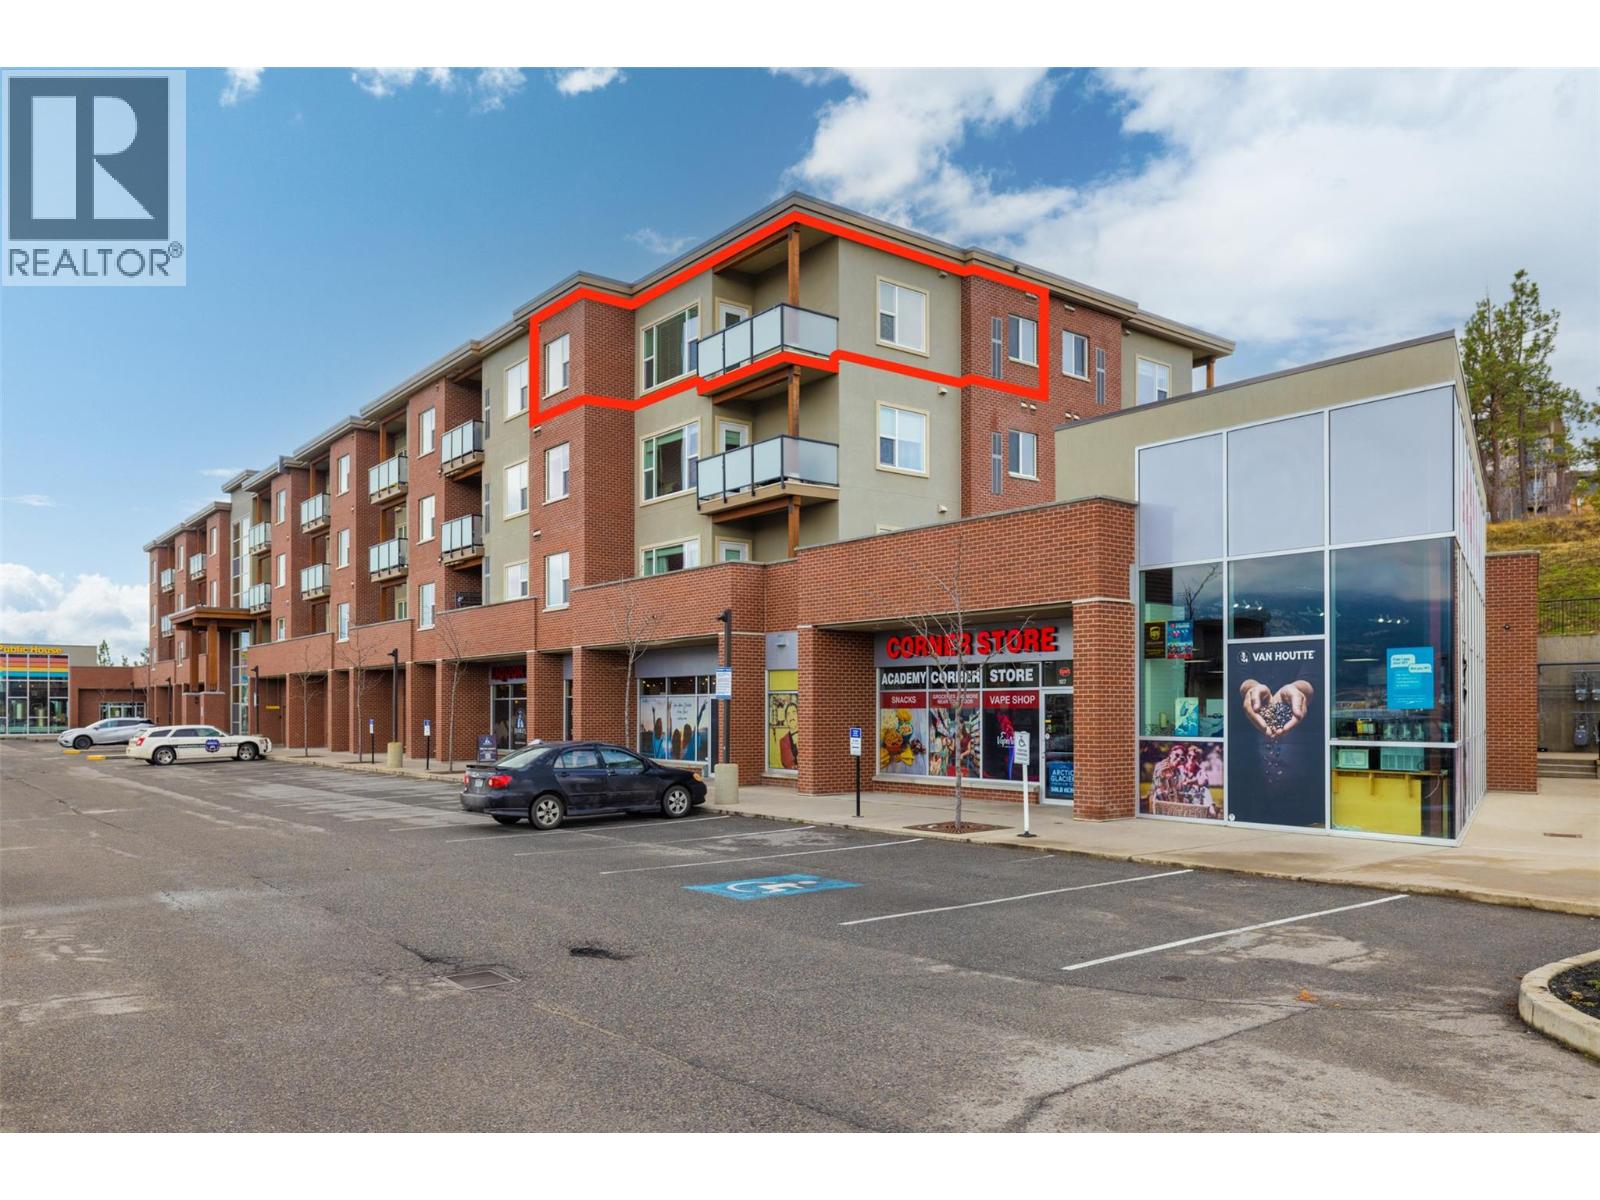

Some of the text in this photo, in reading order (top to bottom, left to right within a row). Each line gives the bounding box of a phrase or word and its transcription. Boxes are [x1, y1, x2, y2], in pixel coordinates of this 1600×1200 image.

[886, 626, 1057, 660] CORNER STORE
[1252, 650, 1315, 661] VAN HOUTTE
[881, 668, 1034, 685] ACADEMY CORNER STORE
[891, 695, 917, 704] SNACKS
[989, 695, 1036, 705] VAPE SHOP
